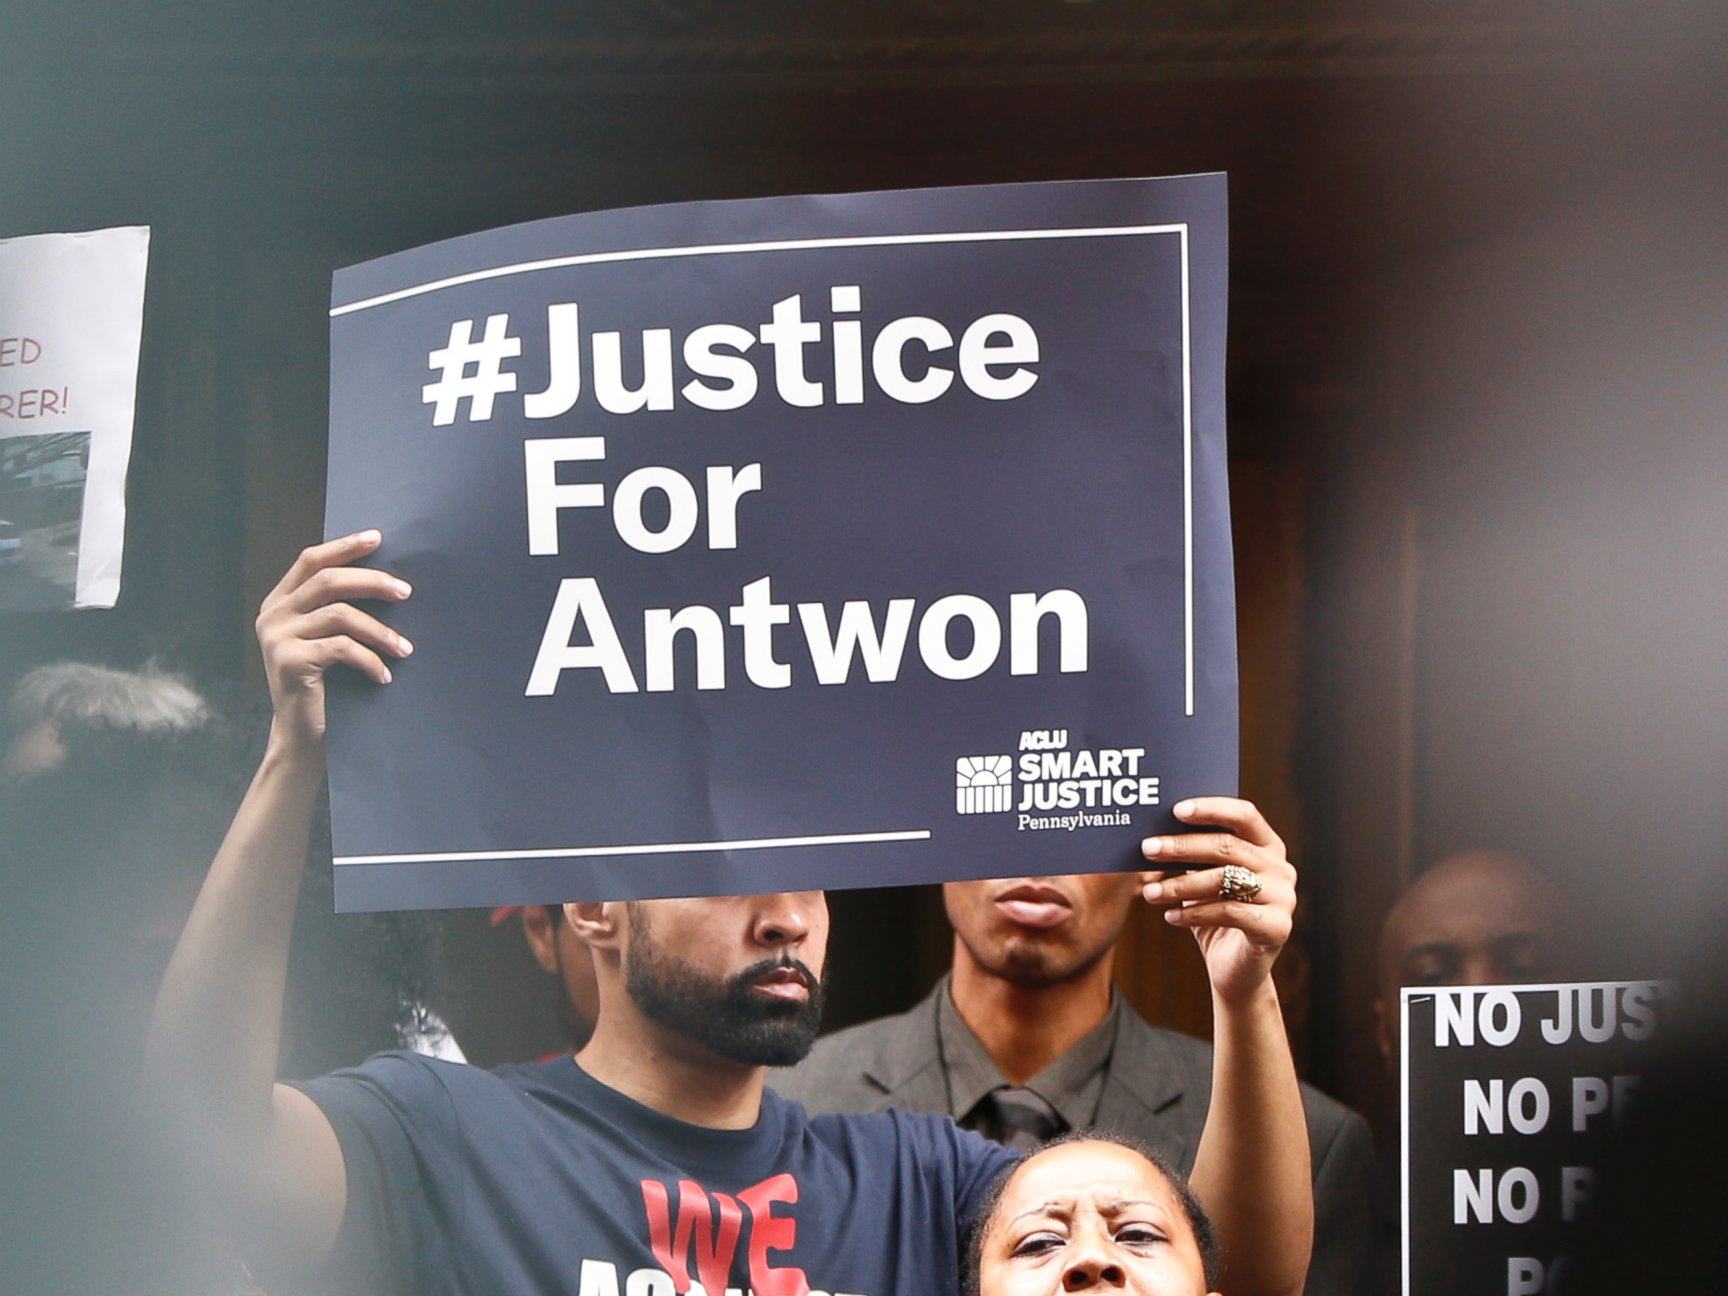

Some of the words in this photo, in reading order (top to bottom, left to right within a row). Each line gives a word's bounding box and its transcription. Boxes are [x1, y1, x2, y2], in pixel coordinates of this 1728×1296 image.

[422, 286, 1040, 426] #Justice
[524, 436, 762, 555] For
[524, 576, 1088, 696] Antwon
[1018, 729, 1068, 751] ACLU
[1018, 748, 1145, 781] SMART
[1017, 809, 1132, 831] Pennsylvania
[1018, 777, 1160, 811] JUSTICE
[1435, 990, 1521, 1047] NO
[1463, 1077, 1550, 1135] NO
[1453, 1167, 1540, 1224] NO
